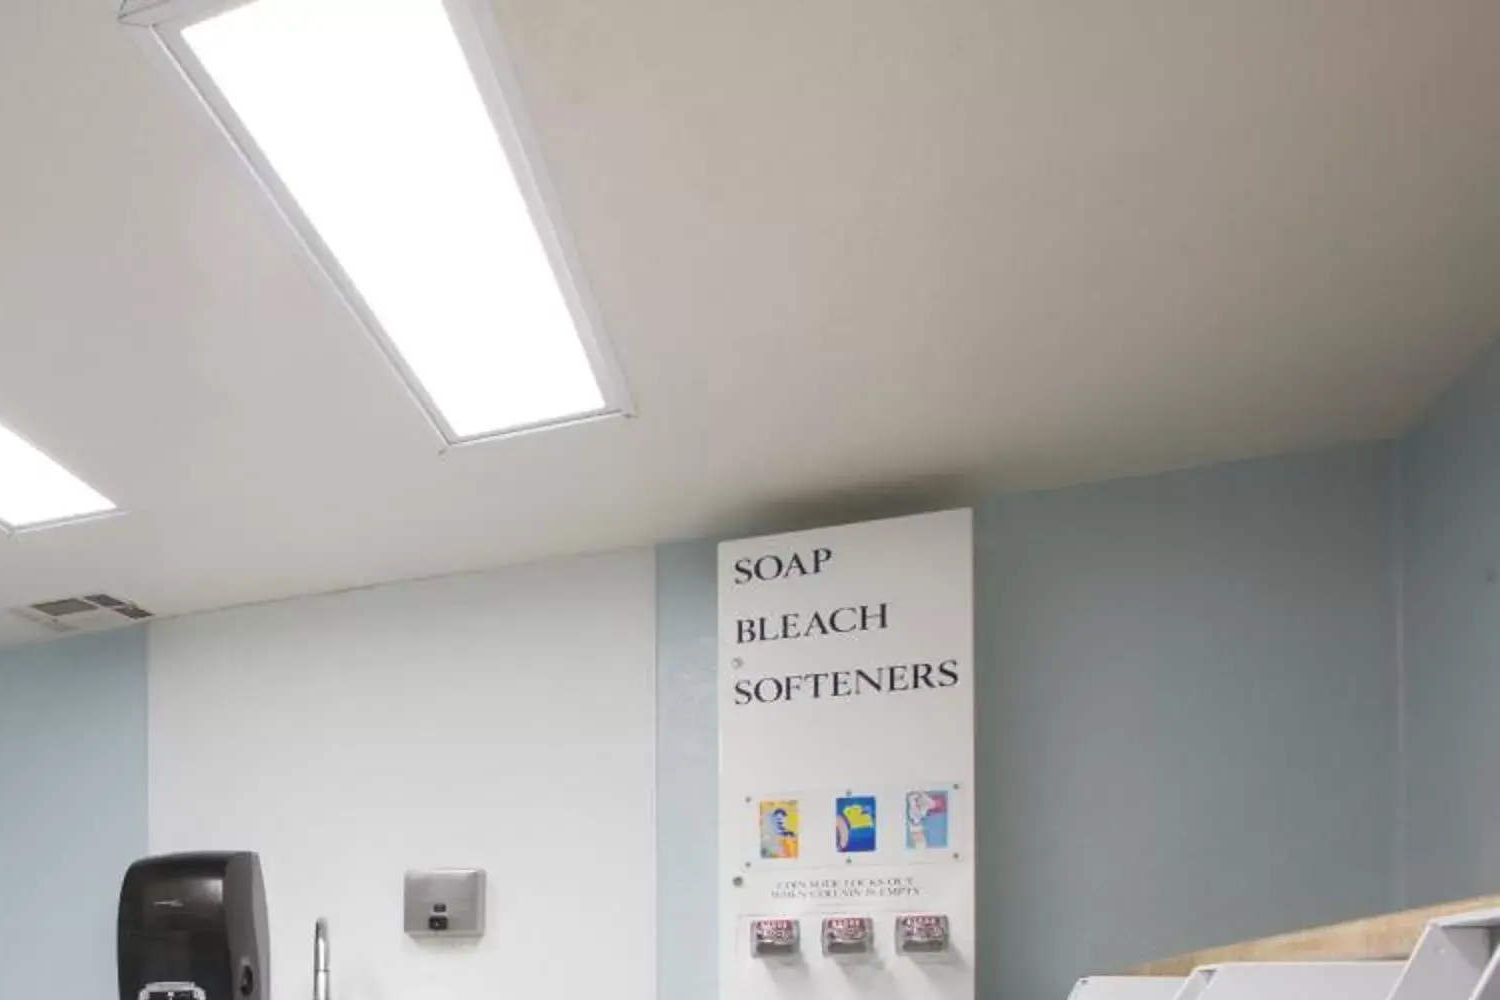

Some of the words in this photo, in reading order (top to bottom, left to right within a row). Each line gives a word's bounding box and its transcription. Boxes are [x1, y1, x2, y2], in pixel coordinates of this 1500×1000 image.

[734, 548, 832, 585] SOAP
[736, 603, 889, 644] BLEACH
[734, 659, 959, 705] SOFTENERS
